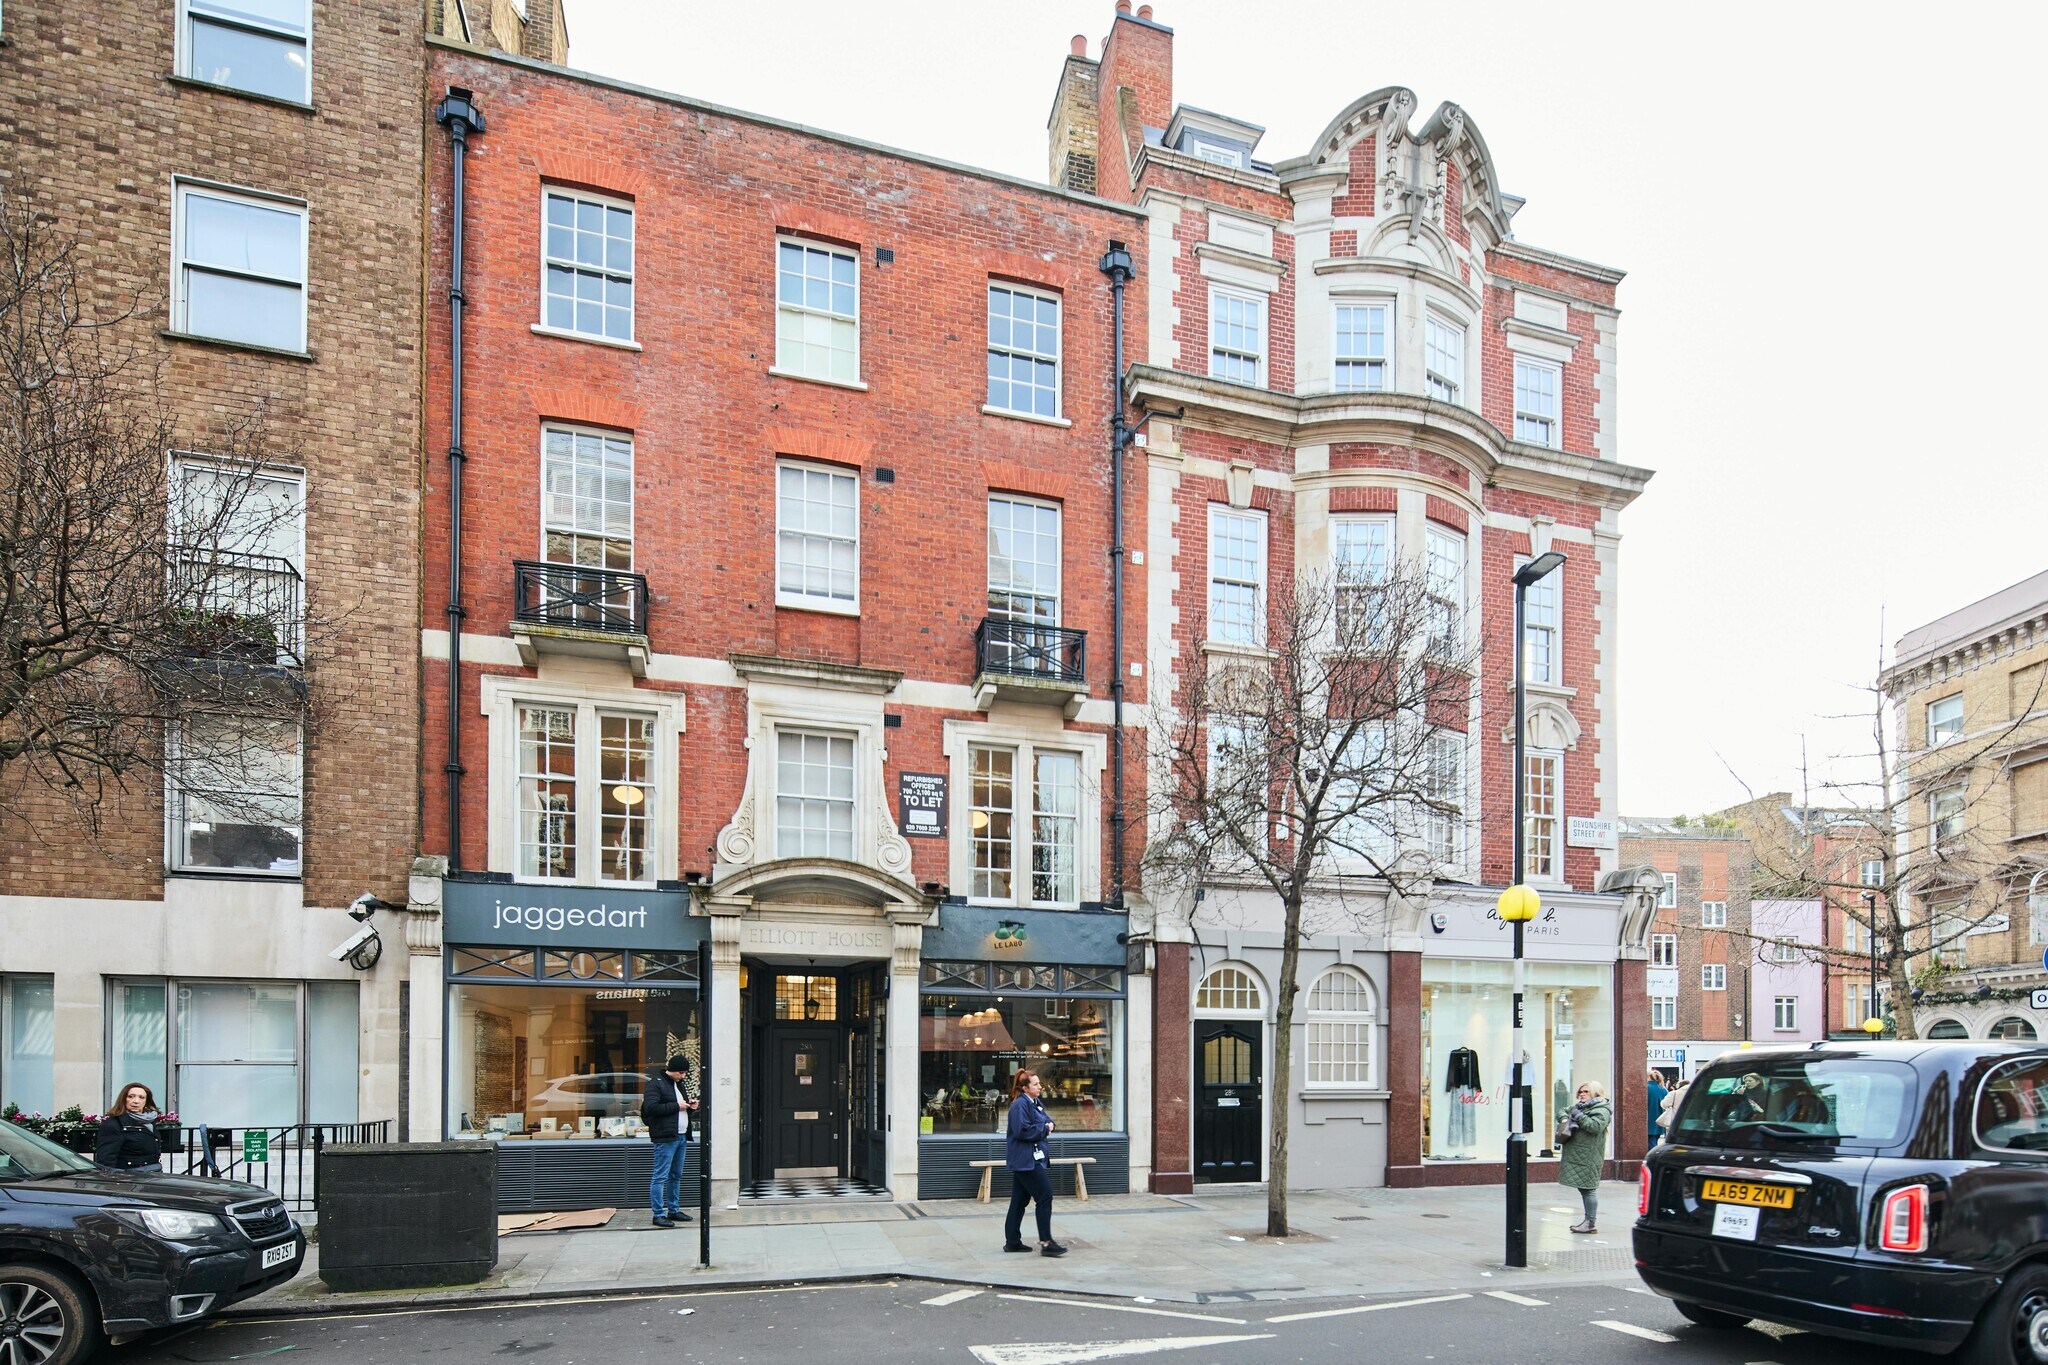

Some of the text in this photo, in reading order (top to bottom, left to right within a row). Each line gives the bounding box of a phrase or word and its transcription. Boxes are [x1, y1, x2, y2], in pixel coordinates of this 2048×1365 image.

[903, 775, 943, 784] REFURBISHED
[903, 795, 943, 807] TO LET
[1573, 820, 1611, 830] DEVONSHIRE
[1573, 829, 1595, 838] STREET
[493, 899, 648, 931] jaggedart
[1527, 926, 1560, 936] PARIS
[749, 929, 883, 947] ELLIOTT HOUSE
[1004, 940, 1023, 948] LABO
[1459, 1089, 1490, 1105] sales
[1708, 1182, 1787, 1204] LA69 ZNM
[266, 1243, 293, 1264] RX19 ZST
